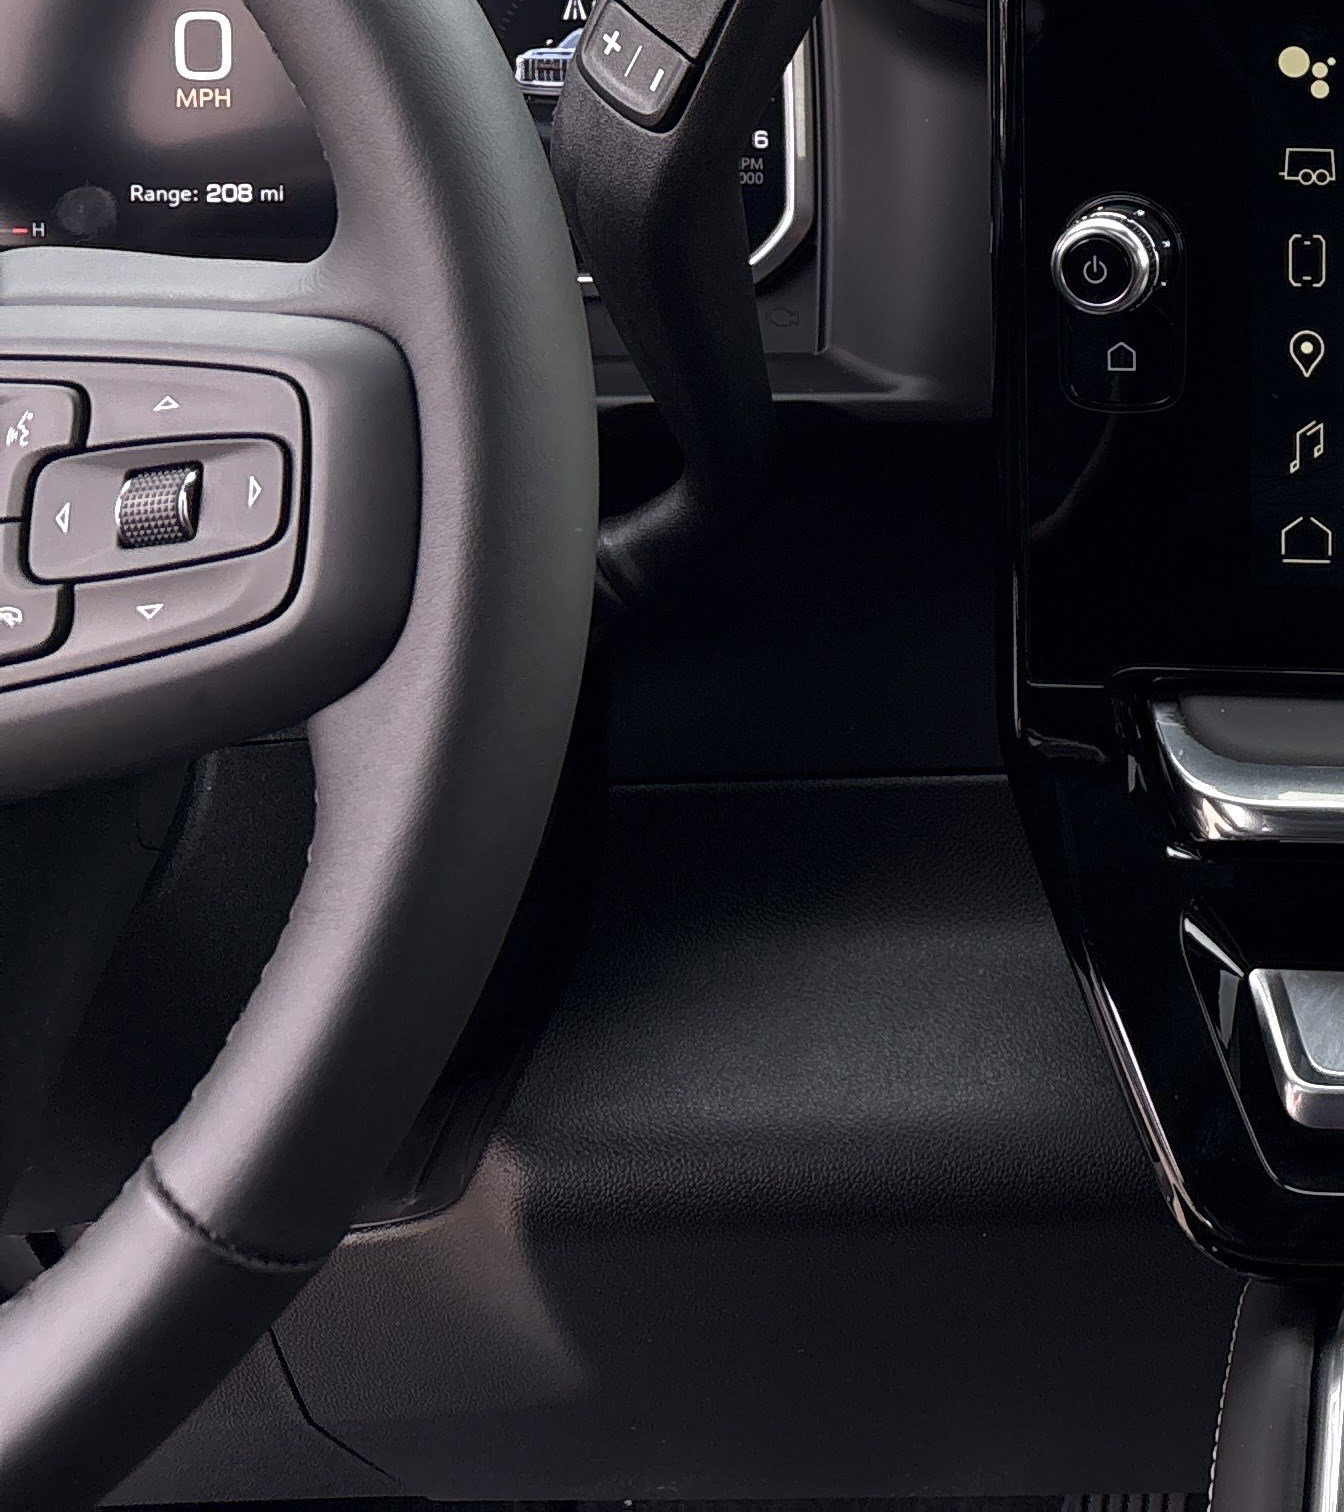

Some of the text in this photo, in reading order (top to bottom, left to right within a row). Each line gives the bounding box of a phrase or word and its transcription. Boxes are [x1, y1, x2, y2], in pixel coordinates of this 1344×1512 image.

[174, 10, 232, 81] 0
[176, 88, 231, 108] MPH
[753, 130, 769, 149] 6
[739, 158, 763, 170] PM
[130, 183, 285, 208] Range: 208 mi
[32, 222, 45, 238] H
